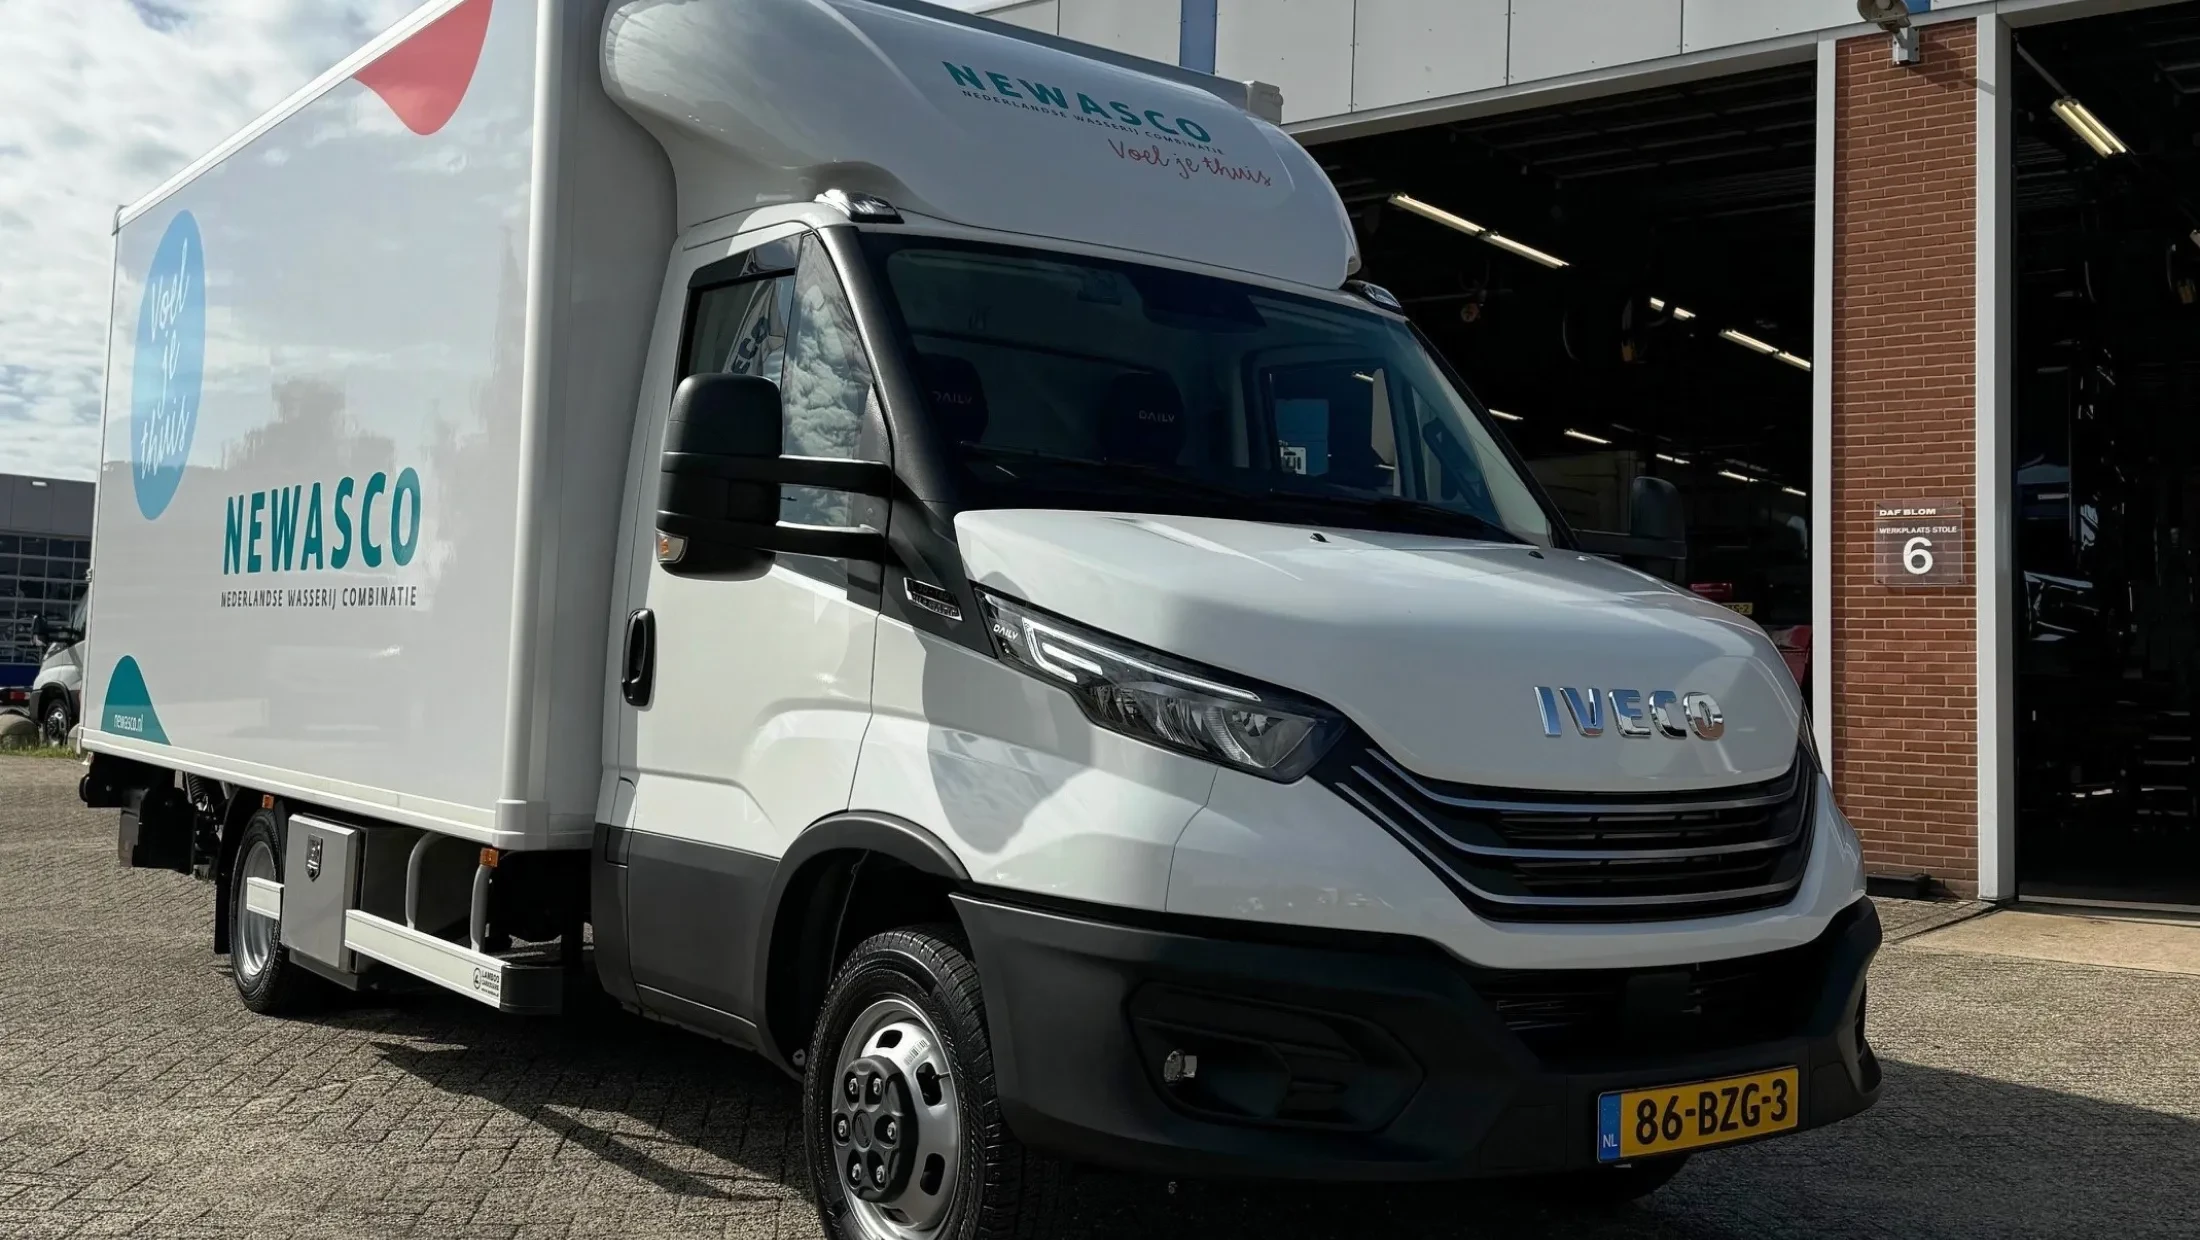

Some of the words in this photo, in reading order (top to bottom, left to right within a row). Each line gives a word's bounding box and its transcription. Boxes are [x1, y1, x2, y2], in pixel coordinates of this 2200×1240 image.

[941, 60, 1212, 144] NEWASCO
[961, 89, 1067, 118] NEDERLANDSE
[1073, 113, 1140, 136] WASSERIJ
[1145, 130, 1225, 155] COMBINATIE
[1107, 138, 1170, 166] Voel
[1174, 152, 1200, 180] je
[1202, 156, 1272, 187] thuis
[151, 237, 190, 342] Voel
[157, 329, 181, 419] je
[140, 395, 190, 479] thuis
[223, 466, 422, 576] NEWASCO
[1879, 526, 1931, 534] WERKPLAATS
[1903, 508, 1936, 516] BLOM
[1903, 537, 1934, 575] 6
[220, 588, 284, 608] NEDERLANDSE
[287, 588, 337, 611] WASSERIJ
[342, 585, 417, 608] COMBINATIE
[993, 623, 1019, 641] DAILY
[1533, 685, 1726, 741] IVECO
[1635, 1078, 1789, 1146] 86-BZG-3
[1602, 1133, 1618, 1149] NL
